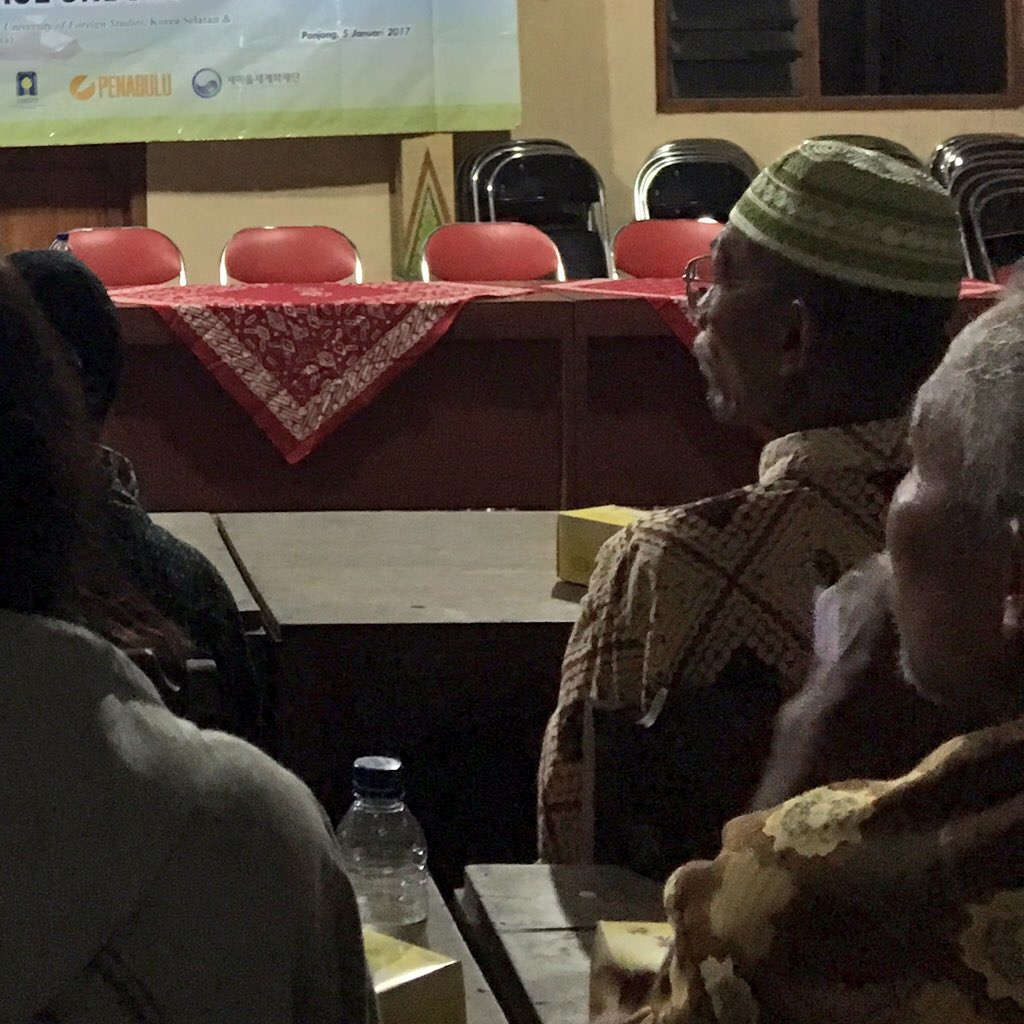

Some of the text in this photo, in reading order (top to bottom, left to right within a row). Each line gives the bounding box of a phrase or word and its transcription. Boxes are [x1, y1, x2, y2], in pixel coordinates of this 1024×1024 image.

[150, 17, 180, 26] Korea
[342, 28, 348, 37] 5
[352, 28, 384, 37] Januari
[387, 27, 411, 36] 2017
[98, 73, 173, 98] PENABULU
